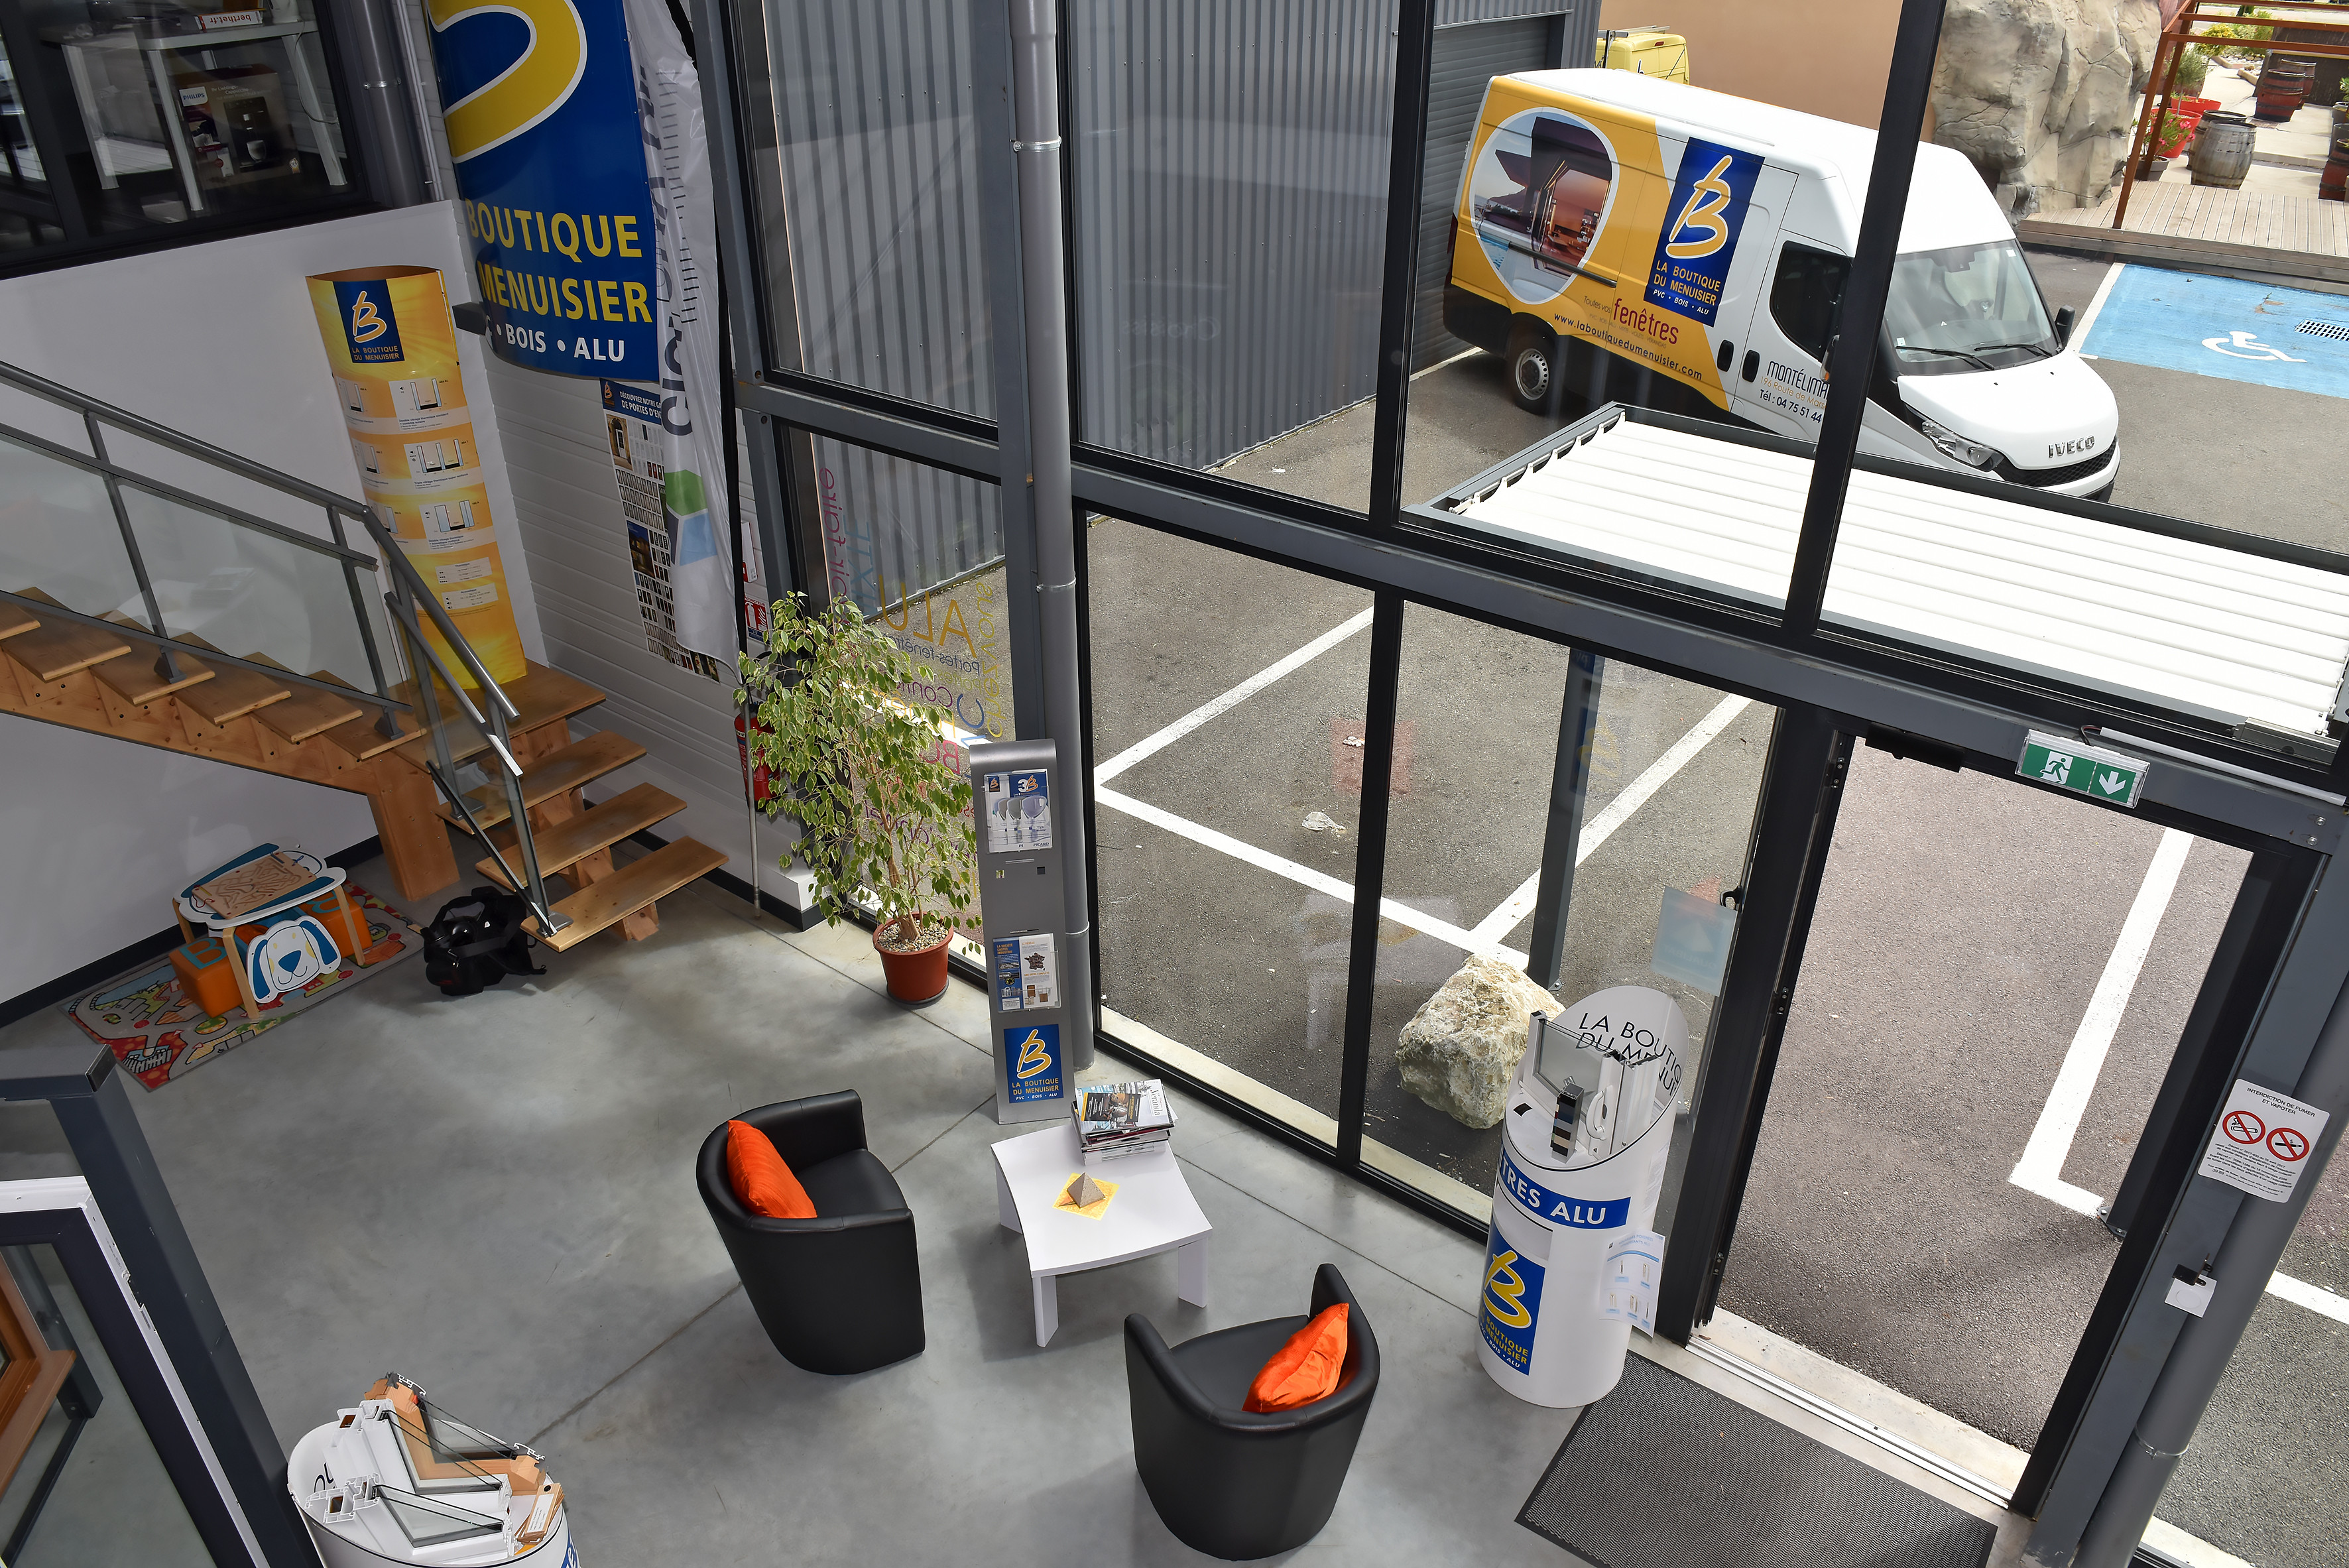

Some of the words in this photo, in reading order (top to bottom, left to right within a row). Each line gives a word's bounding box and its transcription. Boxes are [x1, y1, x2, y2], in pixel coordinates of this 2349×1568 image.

[210, 15, 251, 25] berthet.fr
[465, 199, 642, 263] BOUTIQUE
[1654, 274, 1667, 286] DU
[1670, 280, 1717, 306] MENUISIER
[1656, 260, 1667, 273] LA
[1673, 266, 1721, 292] BOUTIQUE
[477, 260, 652, 323] MENUISIER
[1653, 289, 1665, 298] PVC
[1674, 297, 1689, 307] BOIS
[1584, 296, 1601, 310] Toutes
[1600, 304, 1611, 314] vos
[1613, 298, 1679, 345] fenêtres
[507, 324, 546, 352] BOIS
[573, 337, 625, 362] ALU
[1554, 313, 1703, 381] www.laboutiquedumenuisier.com
[1761, 377, 1772, 387] 196
[1773, 382, 1794, 396] Route
[1767, 361, 1829, 399] MONTÉLIMA
[620, 391, 642, 403] DÉCOUVREZ
[643, 398, 655, 406] NOTRE
[622, 400, 629, 409] DE
[629, 402, 648, 415] PORTES
[1777, 396, 1787, 408] 04
[1789, 401, 1799, 413] 75
[1800, 406, 1810, 418] 51
[1811, 412, 1823, 423] 44
[2048, 436, 2096, 459] IVECO
[1575, 1032, 1614, 1052] DU
[1579, 1013, 1609, 1032] LA
[1620, 1022, 1681, 1084] BOUTIQ
[1025, 1078, 1059, 1087] BOUTIQUE
[1150, 1089, 1163, 1115] Véranda
[2247, 1087, 2286, 1105] INTERDICTION
[2295, 1106, 2315, 1116] FUMER
[2269, 1101, 2296, 1115] VAPOTER
[2231, 1148, 2248, 1157] conditions
[2248, 1156, 2270, 1166] d'application
[2242, 1166, 2265, 1176] d'application
[1499, 1151, 1541, 1208] TRES
[1550, 1201, 1606, 1225] ALU
[1486, 1315, 1528, 1357] BOUTIQUE
[1486, 1324, 1527, 1364] MENUISIER
[1489, 1340, 1501, 1354] BOIS
[1507, 1358, 1520, 1368] ALU
